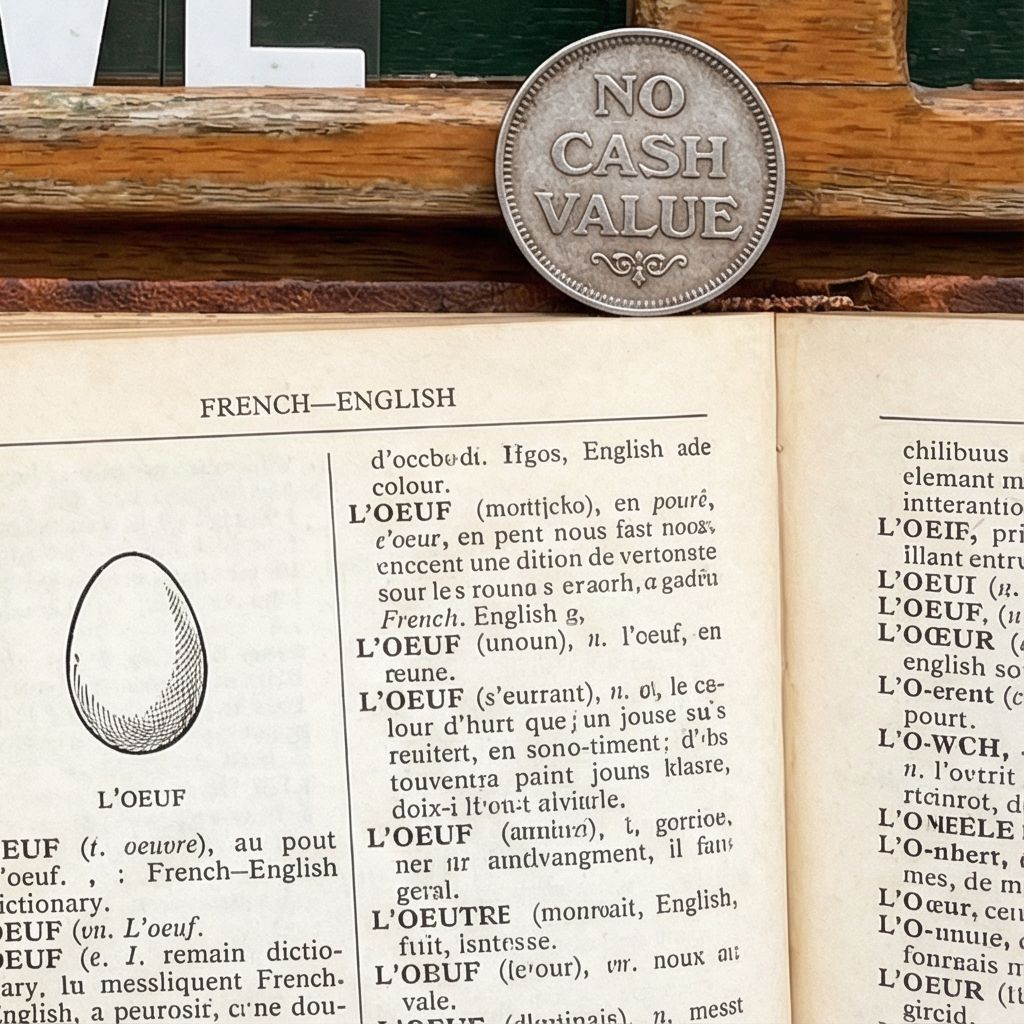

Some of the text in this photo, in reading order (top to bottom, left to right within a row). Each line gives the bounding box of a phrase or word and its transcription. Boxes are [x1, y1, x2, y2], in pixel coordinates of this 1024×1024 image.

[594, 74, 685, 118] NO
[551, 132, 727, 179] CASH
[534, 192, 743, 240] VALUE
[583, 439, 664, 464] English
[678, 437, 711, 456] ade
[903, 440, 1008, 462] chilibuus
[373, 476, 450, 496] colour.
[903, 466, 994, 488] elemant
[349, 501, 451, 524] L'OEUF
[615, 498, 640, 512] en
[458, 531, 484, 546] en
[494, 526, 544, 553] pent
[555, 526, 606, 541] nous
[616, 519, 652, 538] fast
[877, 517, 981, 545] L'OEIF,
[470, 557, 510, 571] une
[517, 549, 582, 569] dition
[589, 547, 614, 566] de
[620, 546, 716, 564] vertonste
[904, 545, 963, 567] illant
[378, 587, 426, 602] sour
[645, 577, 657, 590] a
[381, 608, 465, 629] French.
[474, 603, 557, 629] English
[878, 596, 988, 625] L'OEUF,
[356, 634, 460, 658] L'OEUF
[477, 629, 573, 657] (unoun),
[699, 626, 721, 640] en
[878, 622, 995, 650] L'OŒUR
[385, 667, 455, 683] reune.
[904, 654, 986, 678] english
[359, 688, 464, 712] L'OEUF
[477, 681, 600, 713] (s'eurrant),
[671, 676, 687, 696] le
[387, 717, 434, 737] lour
[444, 714, 514, 735] d'hurt
[584, 714, 610, 728] un
[620, 706, 676, 731] jouse
[904, 710, 975, 729] pourt.
[489, 746, 516, 760] en
[878, 725, 1009, 762] L'O-WCH,
[515, 765, 576, 794] paint
[591, 762, 649, 788] jouns
[97, 787, 186, 809] L'OEUF
[392, 796, 458, 819] doix-i
[124, 832, 213, 858] oeuvre),
[235, 837, 263, 852] au
[282, 831, 336, 861] pout
[367, 824, 473, 848] L'OEUF
[396, 859, 432, 874] ner
[670, 838, 683, 858] il
[904, 870, 955, 892] mes,
[964, 871, 992, 892] de
[372, 905, 510, 930] L'OEUTRE
[656, 887, 737, 916] English,
[123, 916, 203, 941] L'oeuf.
[81, 946, 108, 973] (e.
[164, 942, 245, 964] remain
[267, 939, 342, 961] dictio-
[375, 961, 480, 985] L'OBUF
[654, 951, 705, 969] noux
[101, 971, 242, 997] messliquent
[878, 968, 984, 1003] L'OEUR
[91, 1007, 104, 1021] a
[292, 996, 346, 1016] dou-
[402, 990, 456, 1011] vale.
[690, 997, 743, 1021] messt
